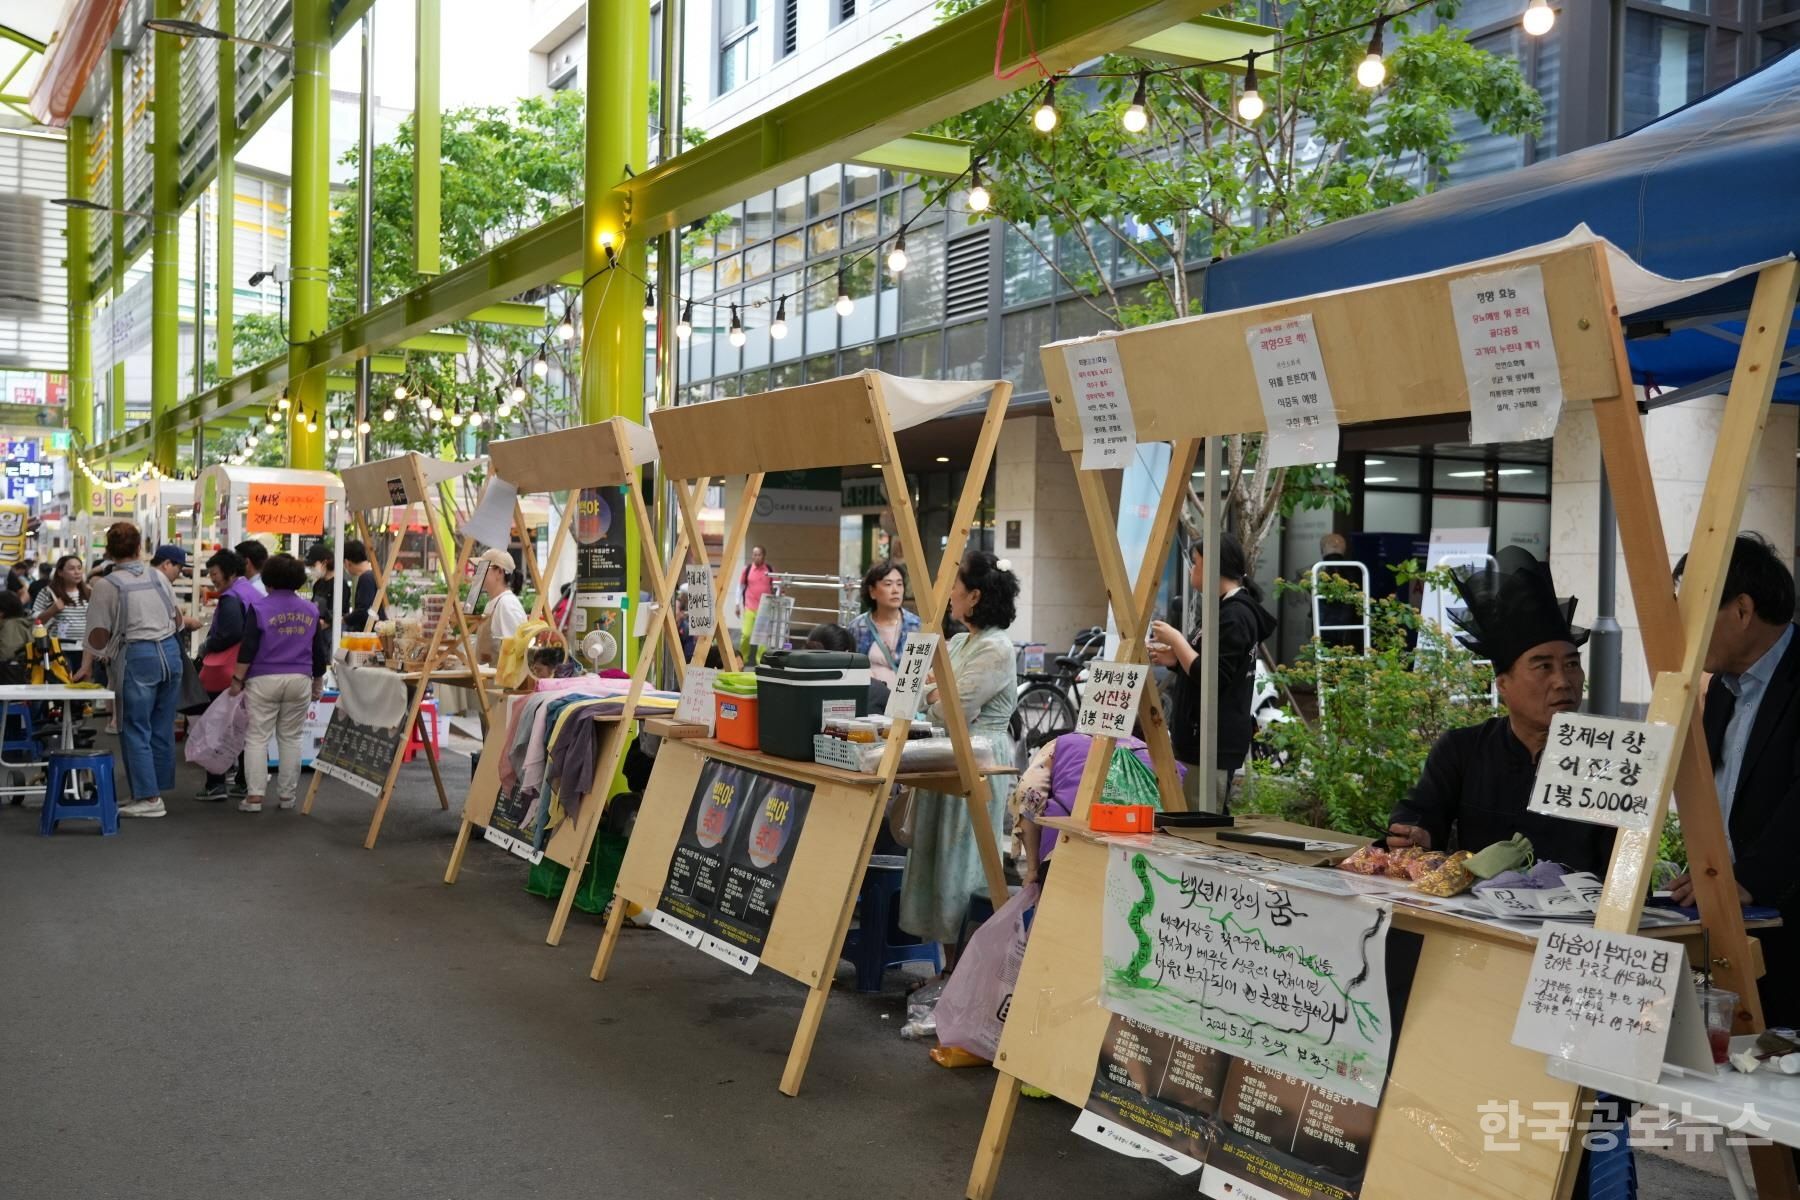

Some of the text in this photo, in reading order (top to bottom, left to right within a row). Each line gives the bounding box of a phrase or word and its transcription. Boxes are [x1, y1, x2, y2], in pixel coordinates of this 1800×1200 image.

[1472, 310, 1500, 323] 당뇨예방
[1515, 306, 1530, 317] 관리
[1488, 326, 1519, 338] 골다공증
[1474, 340, 1540, 357] 고기의 누린내 제거
[1268, 371, 1317, 389] 위를 튼튼하게
[1277, 394, 1317, 408] 식중독 예방
[1093, 668, 1138, 688] 황제의 향
[1093, 690, 1132, 709] 어진향
[1557, 723, 1646, 754] 황제의 향
[712, 781, 735, 808] 백야
[1579, 787, 1648, 816] 5,000원
[765, 797, 790, 826] 백야
[1266, 888, 1309, 926] 꿈
[1547, 932, 1601, 959] 마음이
[1603, 941, 1648, 968] 부자인
[1311, 1098, 1332, 1112] EDM DJ
